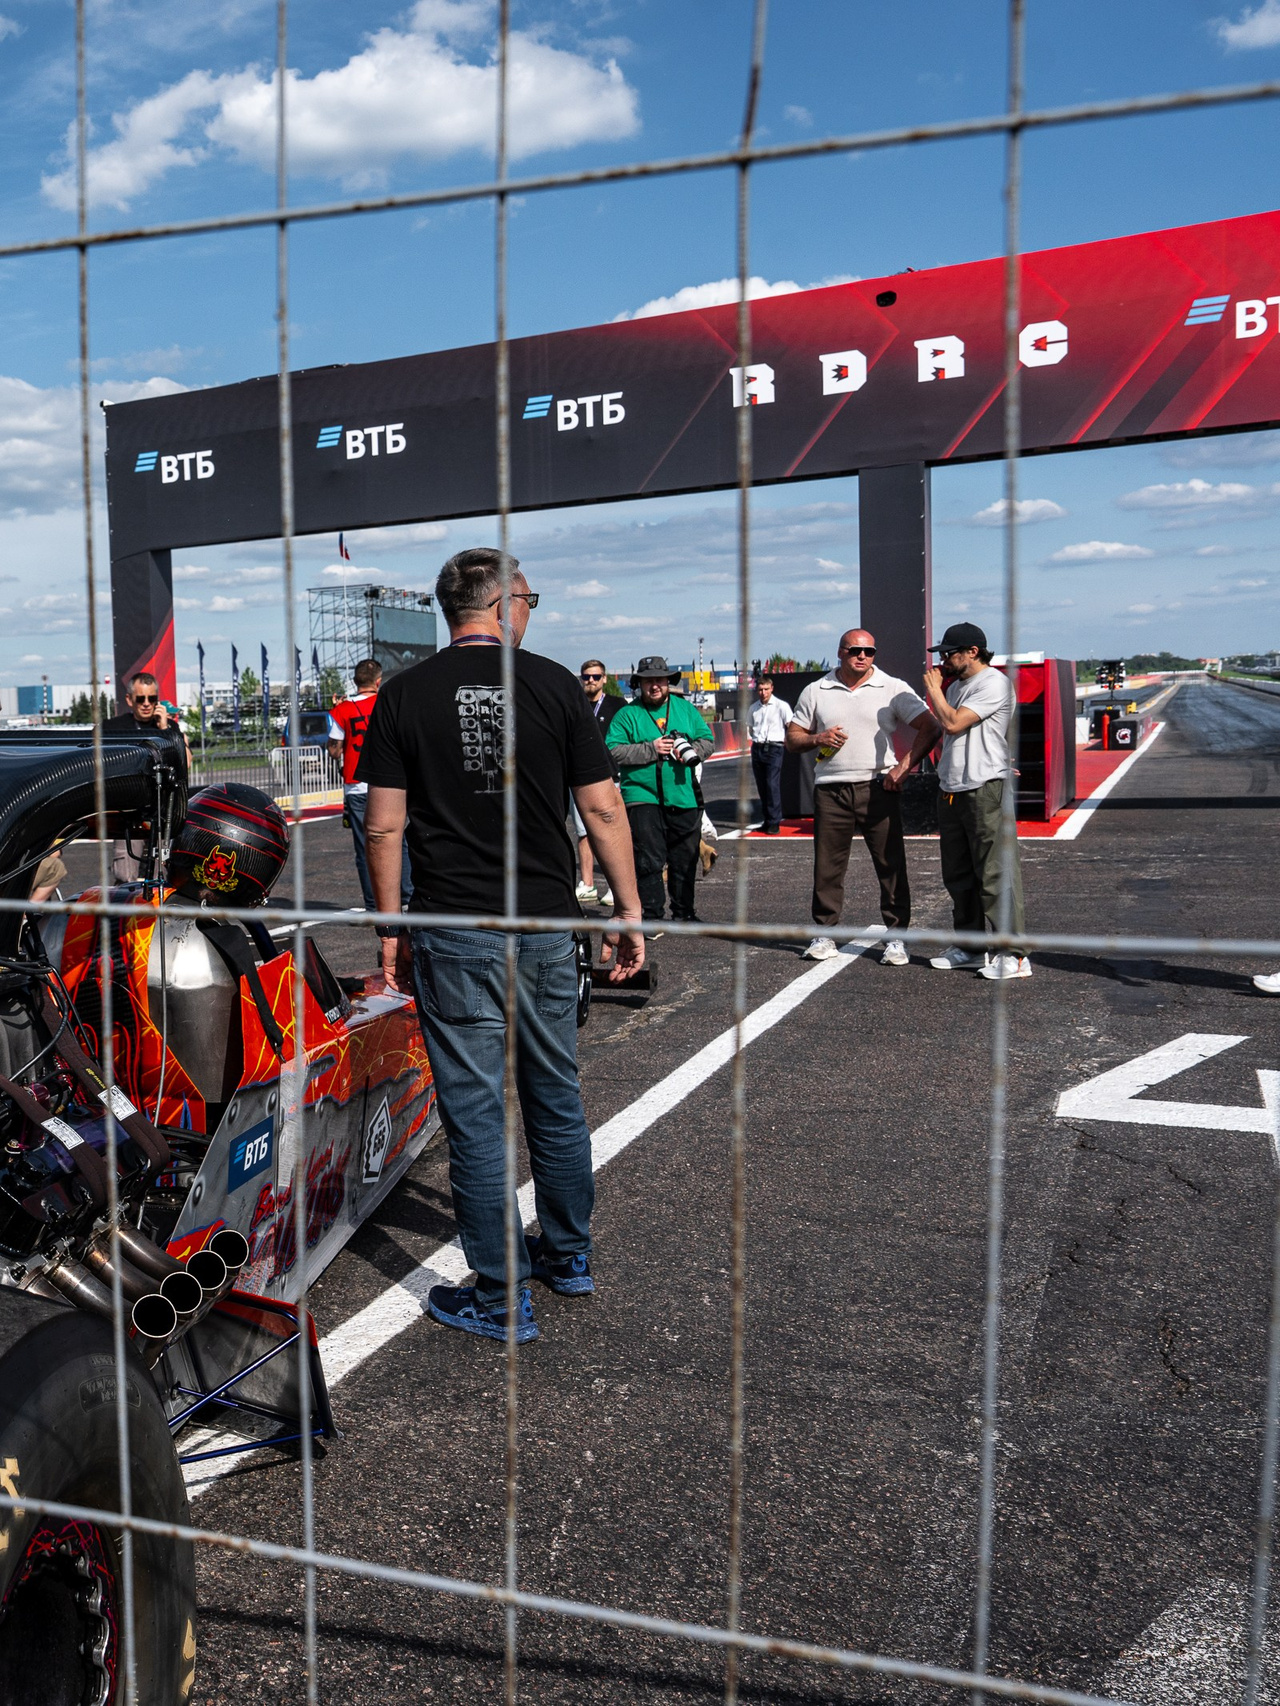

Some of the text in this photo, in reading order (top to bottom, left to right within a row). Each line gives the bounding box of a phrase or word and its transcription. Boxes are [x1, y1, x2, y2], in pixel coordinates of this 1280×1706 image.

[556, 391, 626, 431] ВТБ
[345, 423, 406, 459] ВТБ
[161, 450, 215, 483] ВТБ
[243, 1131, 270, 1171] ВТБ
